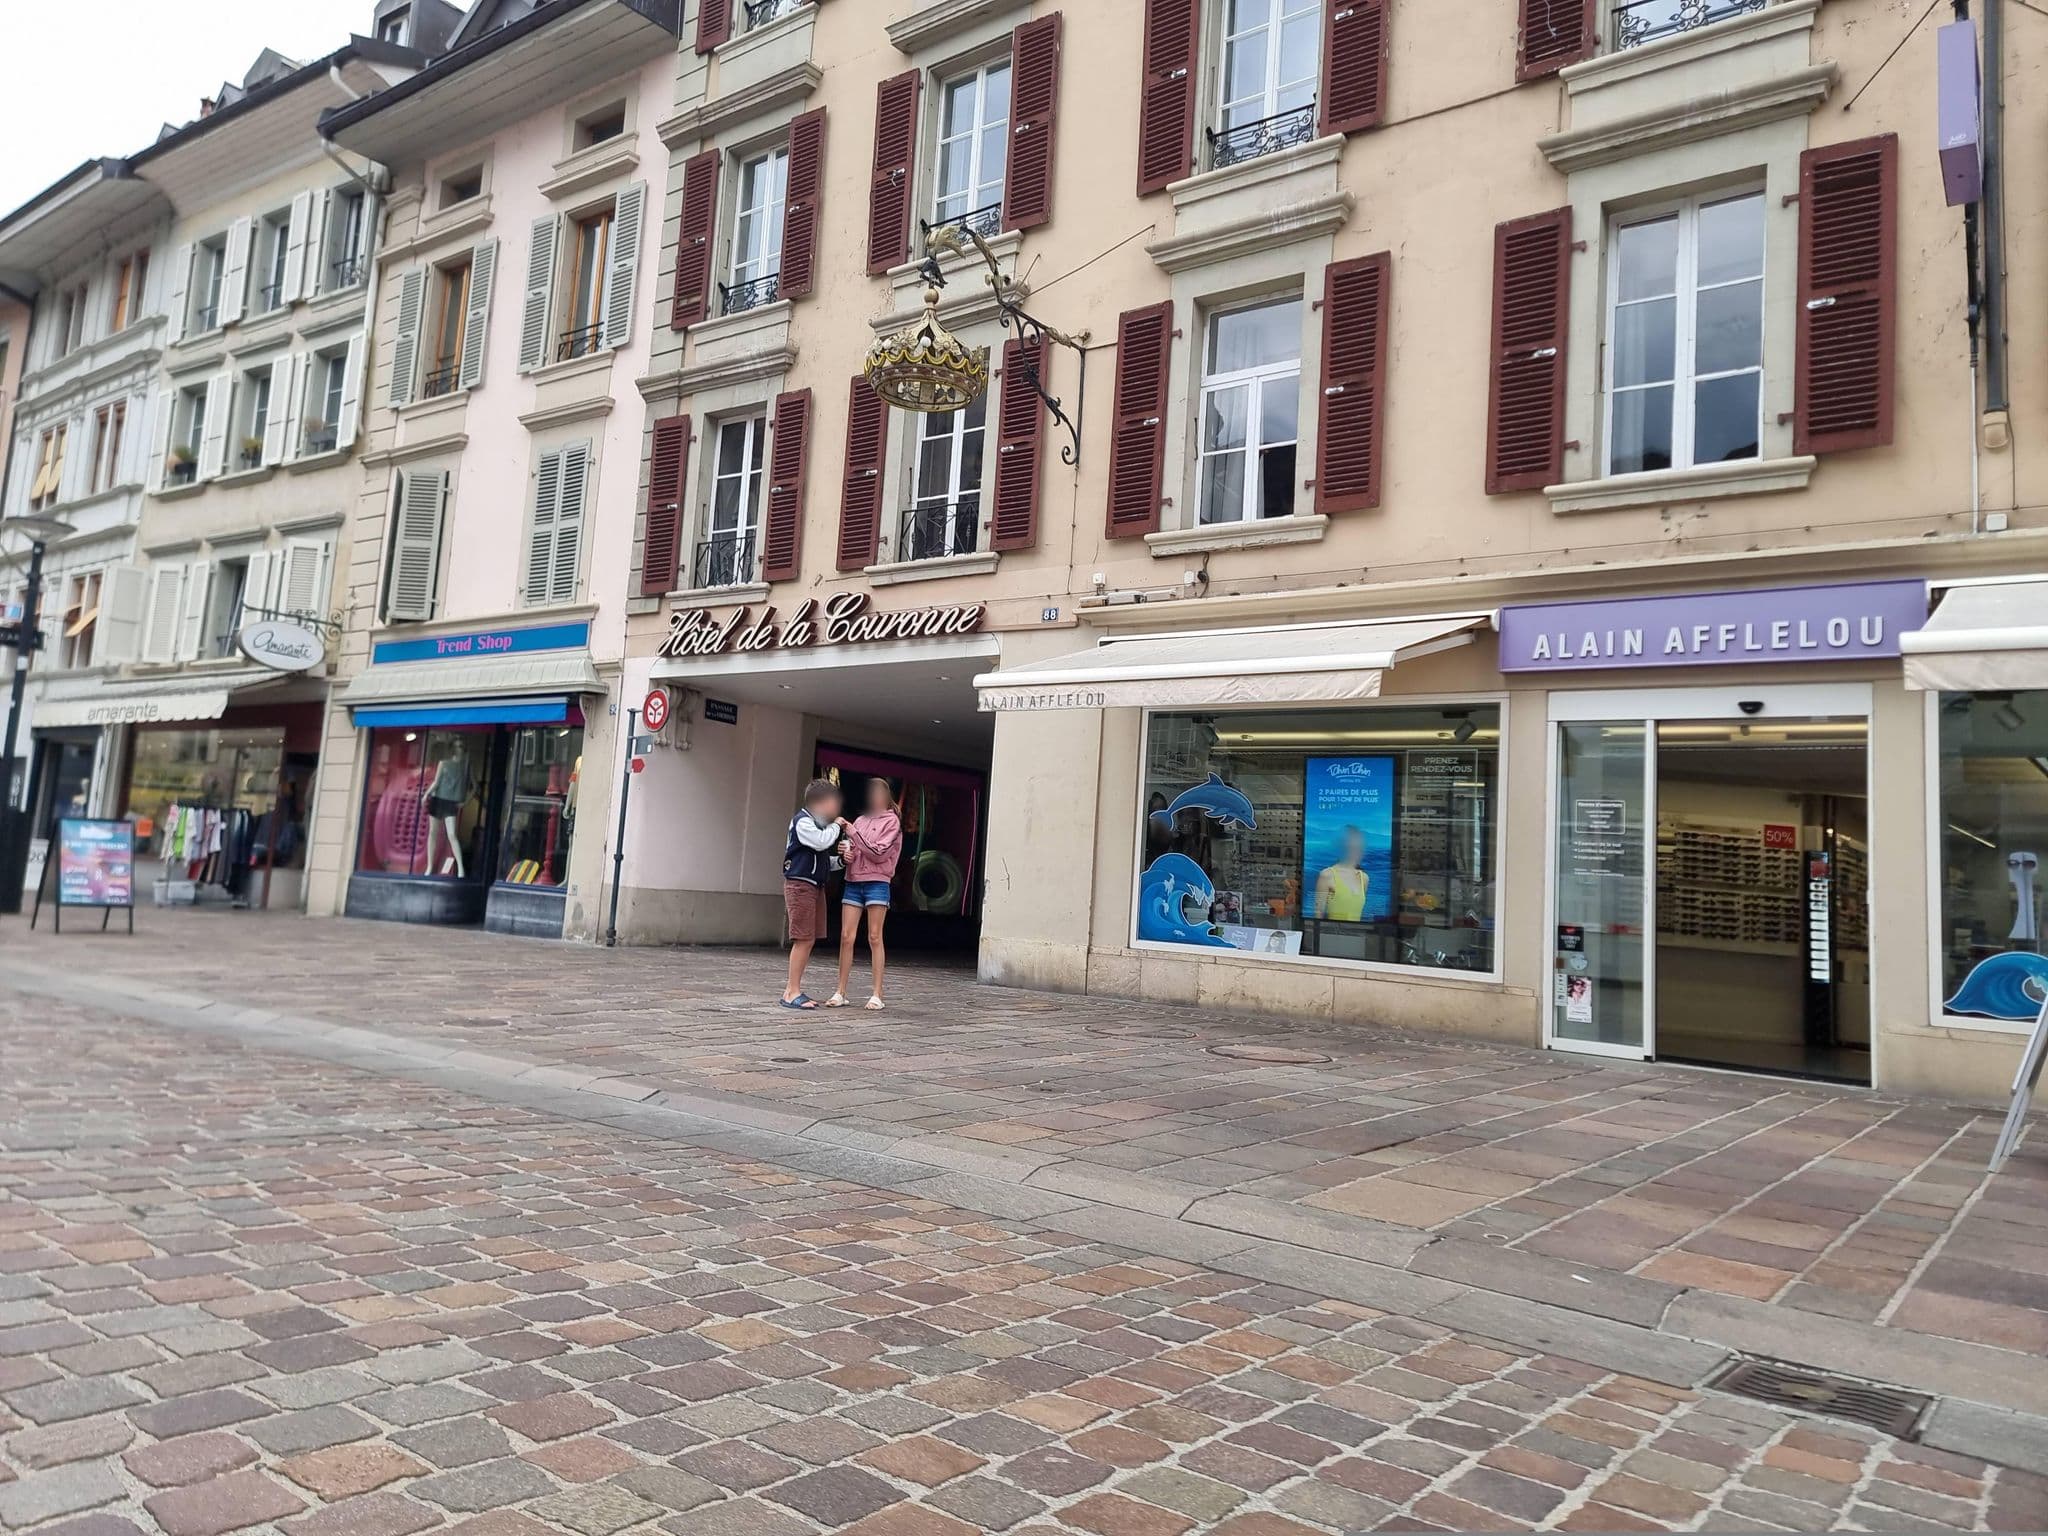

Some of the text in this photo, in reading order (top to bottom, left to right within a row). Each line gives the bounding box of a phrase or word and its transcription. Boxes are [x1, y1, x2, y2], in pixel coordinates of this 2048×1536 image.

[1043, 609, 1057, 621] 88
[656, 592, 986, 657] Hôtel de la Couronne
[436, 635, 513, 654] Trend Shop
[1532, 615, 1884, 660] ALAIN AFFLELOU
[983, 692, 1106, 709] ALAIN AFFLELOU
[88, 702, 159, 721] amarante
[1410, 765, 1473, 773] RENDEZ-VOUS
[1318, 788, 1379, 796] 2 PAIRES DE PLUS
[1362, 796, 1379, 804] PLUS
[1766, 830, 1794, 844] 50%
